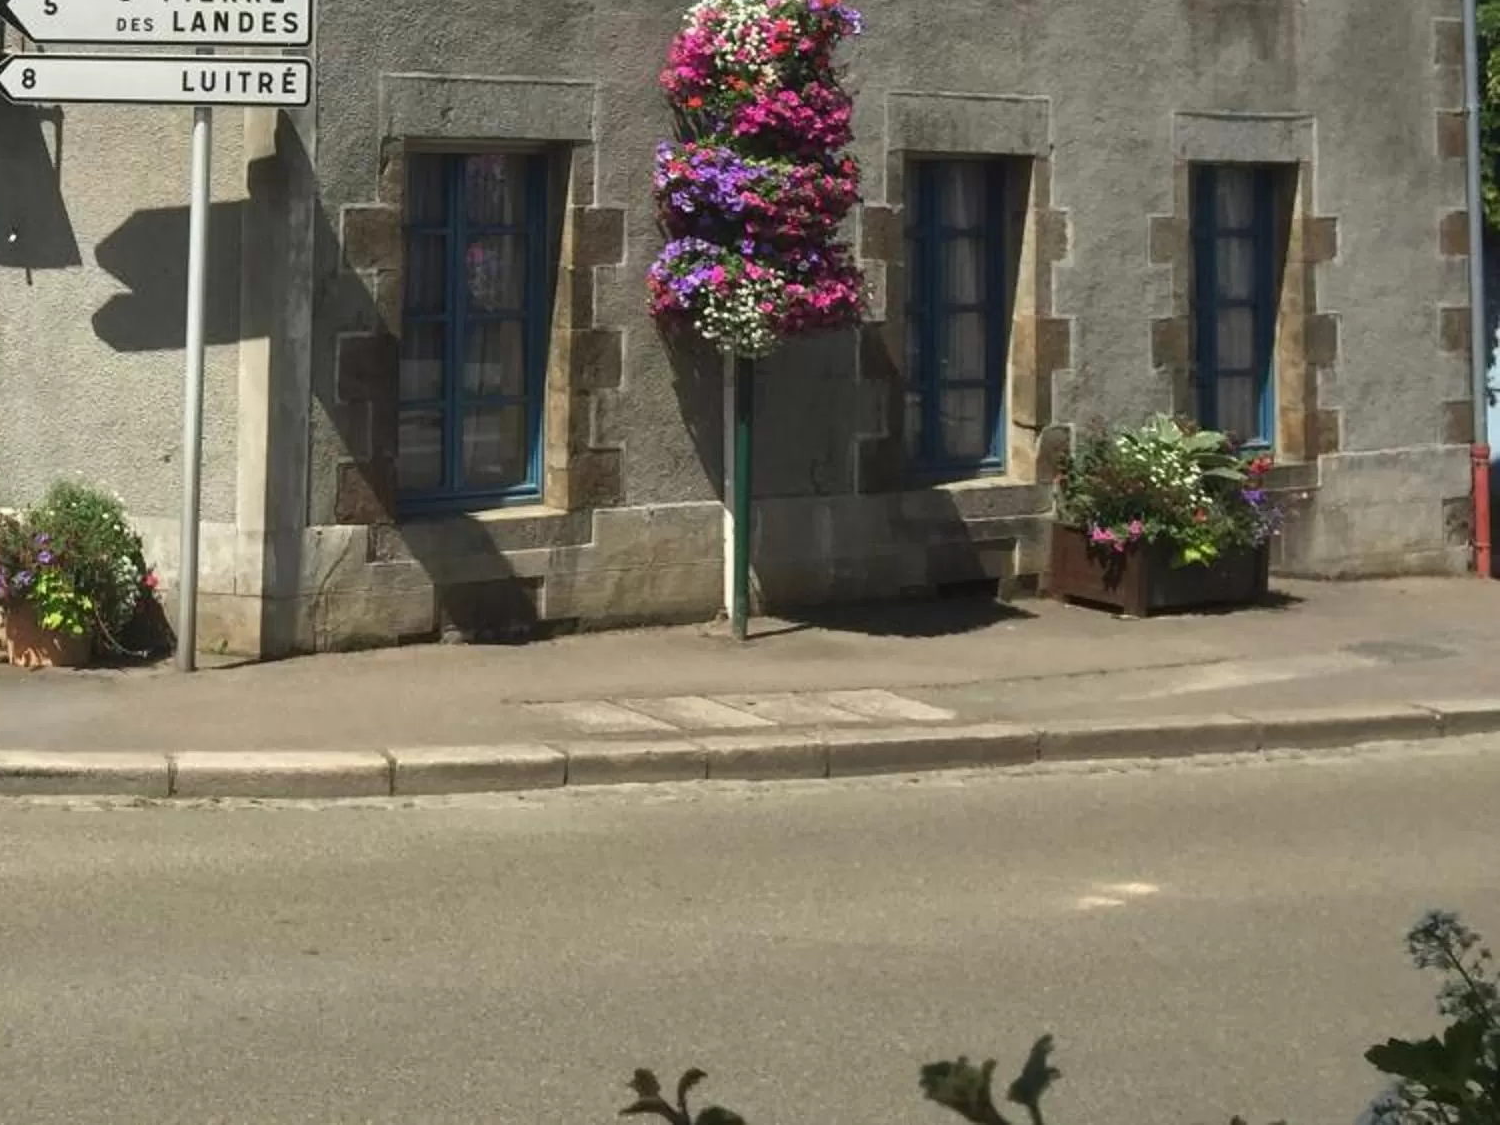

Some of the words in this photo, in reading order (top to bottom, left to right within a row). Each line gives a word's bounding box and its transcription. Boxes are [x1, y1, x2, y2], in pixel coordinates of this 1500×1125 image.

[116, 18, 154, 32] DES
[173, 11, 299, 34] LANDES
[21, 68, 36, 89] 8
[182, 67, 297, 94] LUITRÉ
